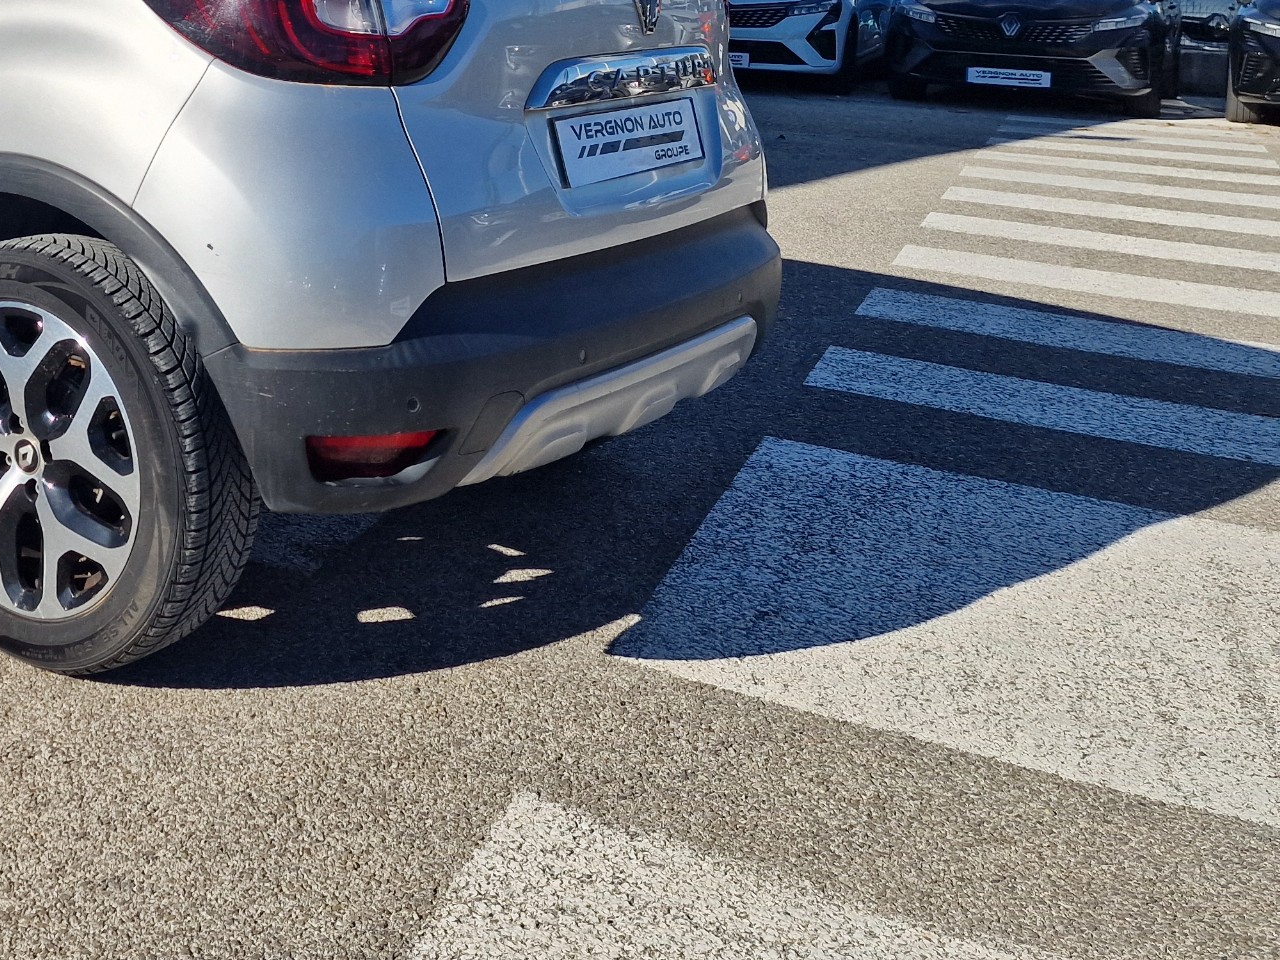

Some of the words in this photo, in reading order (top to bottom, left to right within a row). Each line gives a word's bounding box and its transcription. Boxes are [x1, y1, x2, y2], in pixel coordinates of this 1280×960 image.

[975, 69, 1017, 77] VERGNON
[570, 115, 645, 141] VERGNON
[648, 110, 684, 131] AUTO
[654, 145, 690, 161] GROUPE
